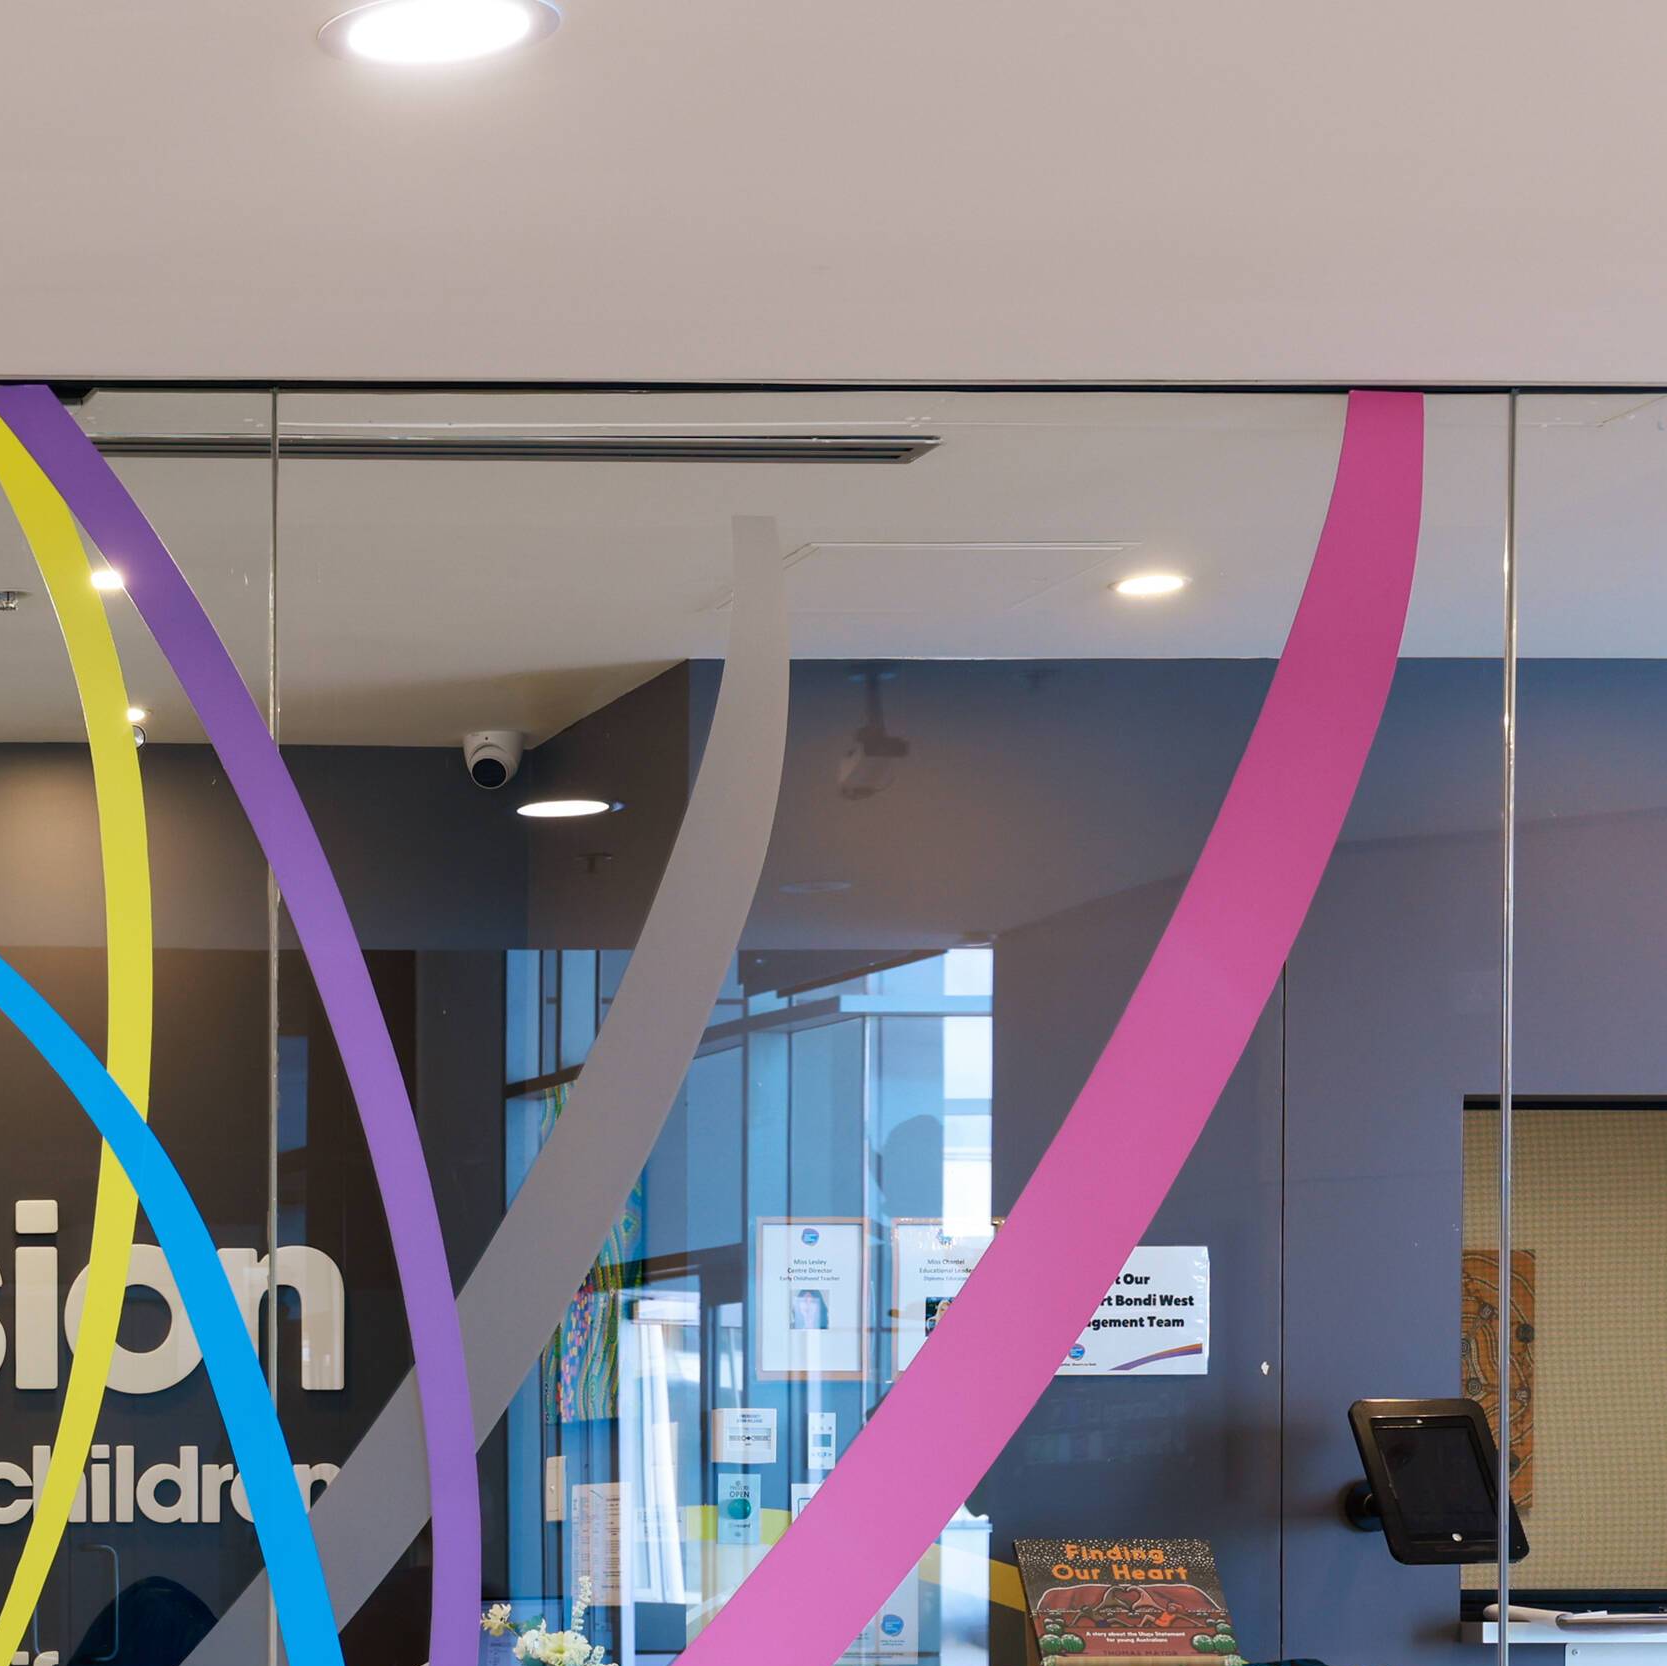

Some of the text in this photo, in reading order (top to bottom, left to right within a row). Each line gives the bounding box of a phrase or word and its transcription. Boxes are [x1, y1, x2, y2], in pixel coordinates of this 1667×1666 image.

[1123, 1273, 1151, 1285] Our
[1115, 1294, 1157, 1306] Bondi
[1159, 1294, 1195, 1306] West
[1147, 1316, 1185, 1328] Team
[1065, 1544, 1165, 1564] Finding
[1051, 1564, 1189, 1580] Our Heart
